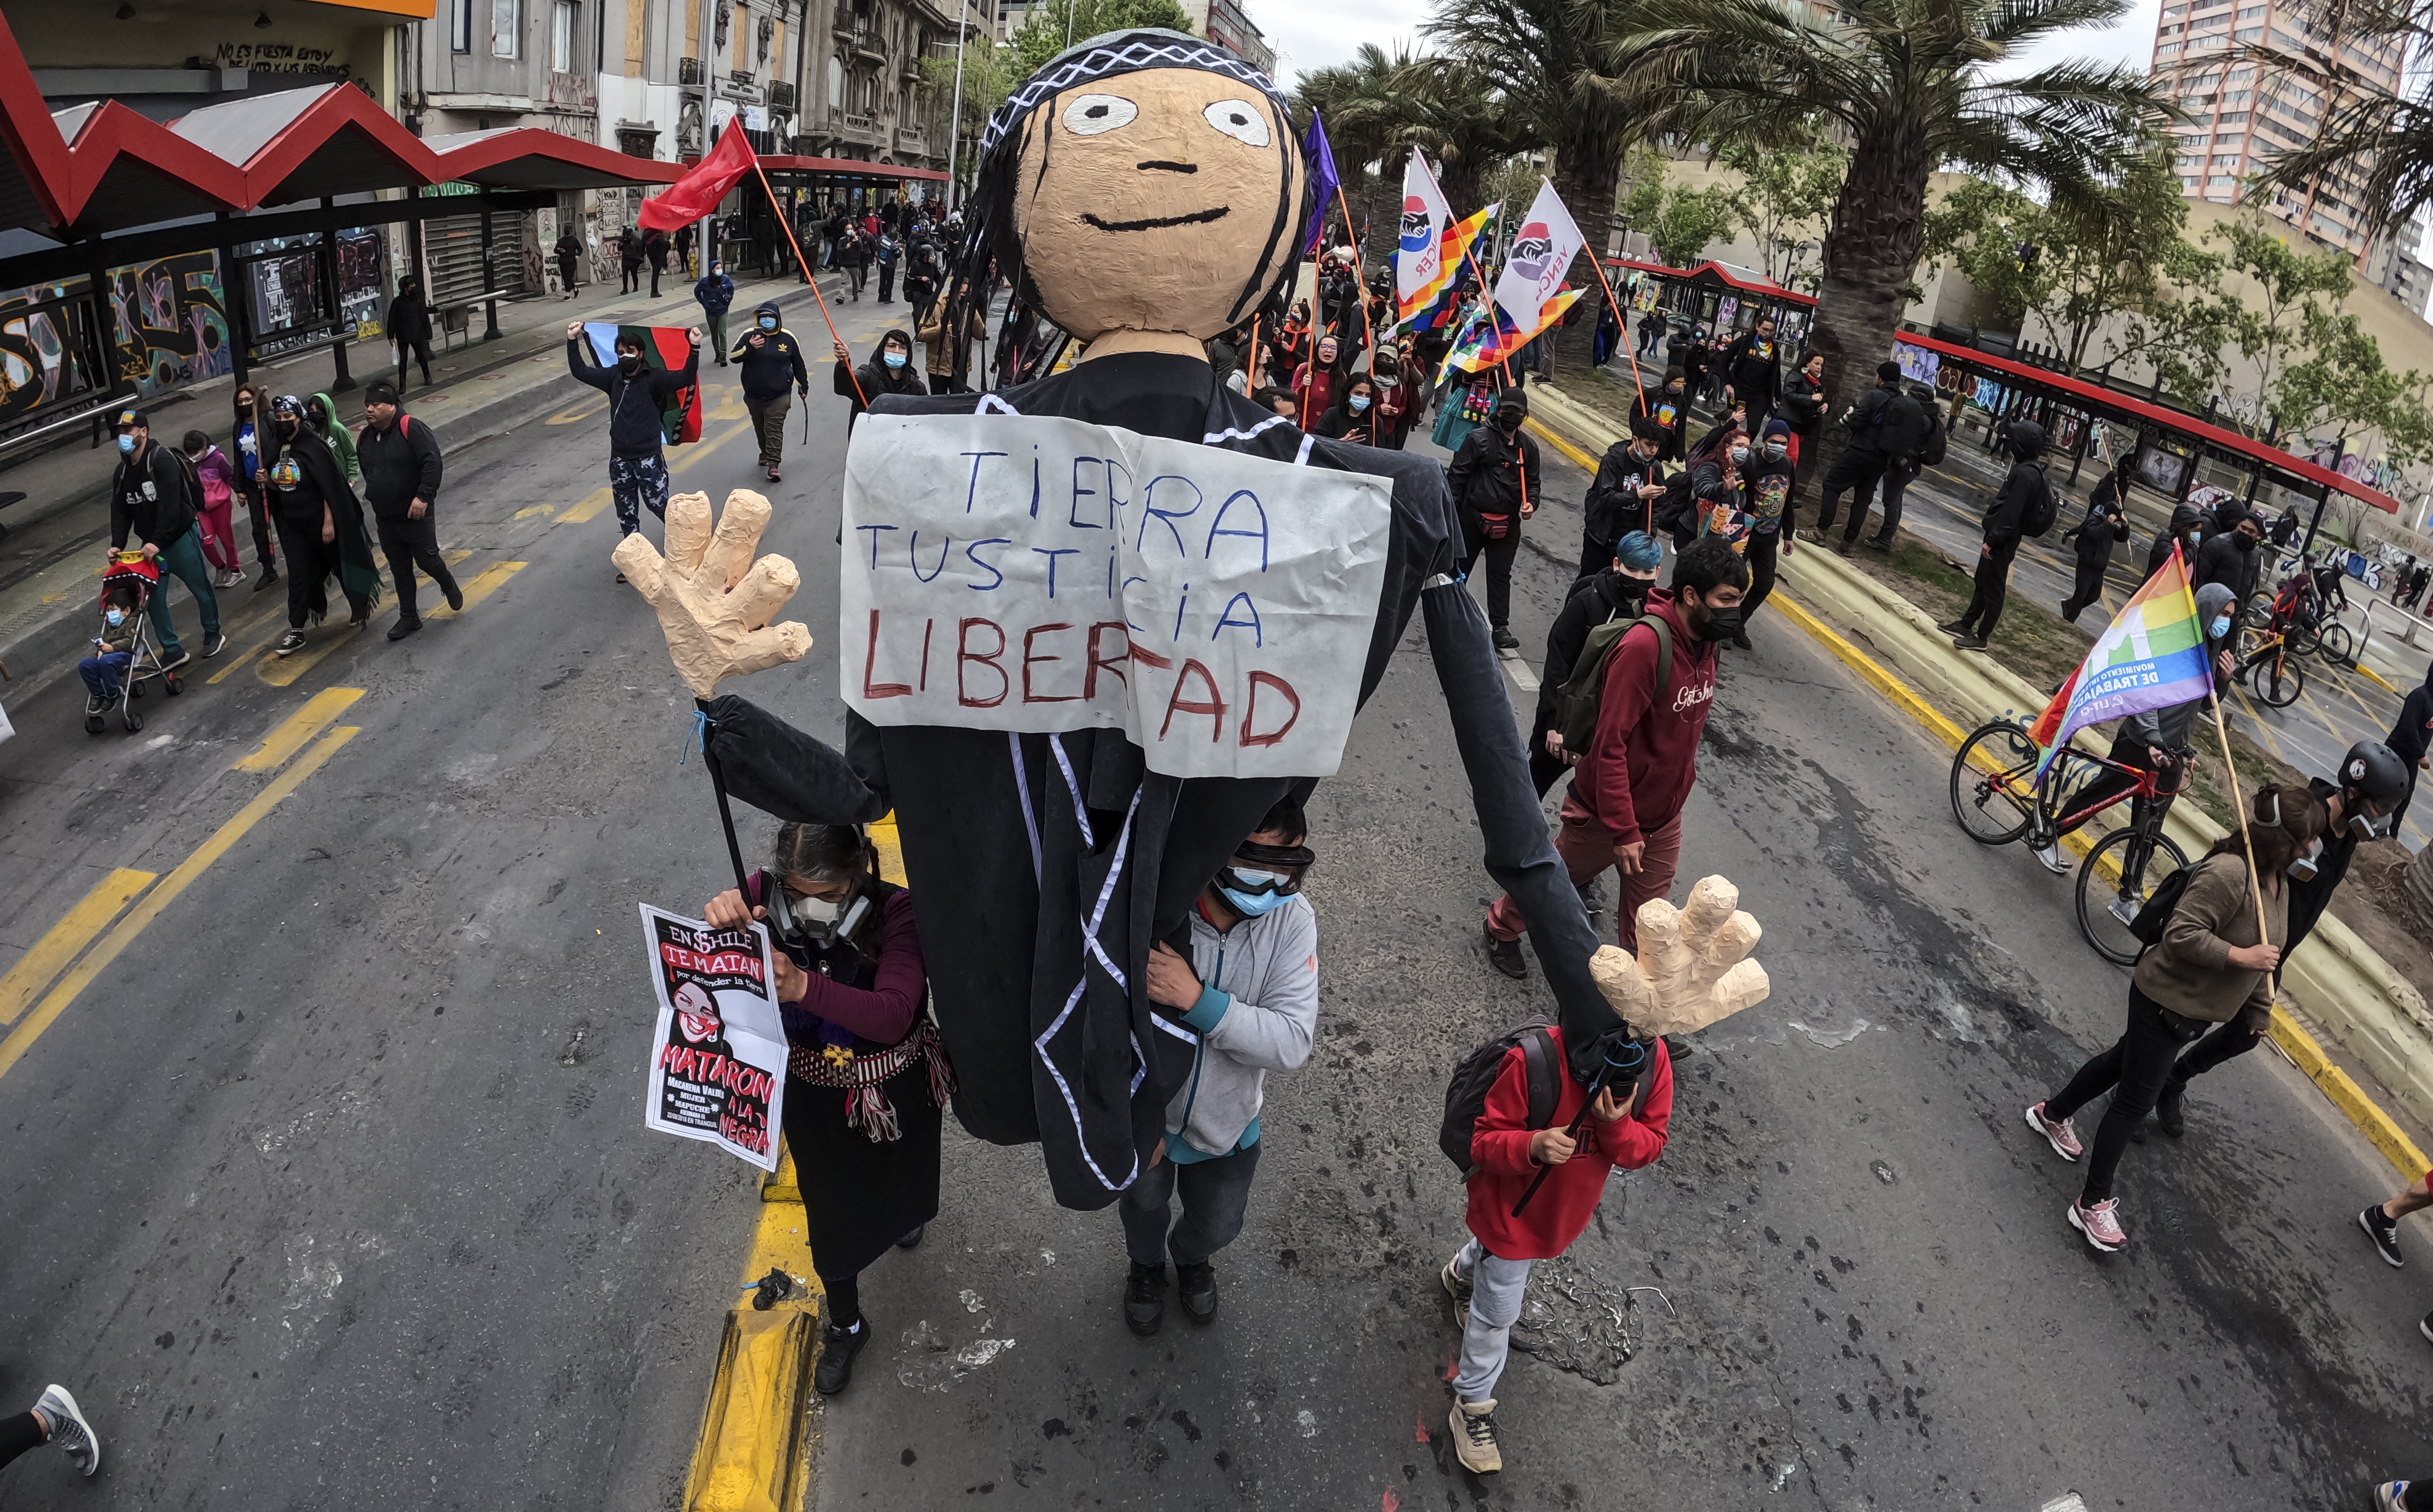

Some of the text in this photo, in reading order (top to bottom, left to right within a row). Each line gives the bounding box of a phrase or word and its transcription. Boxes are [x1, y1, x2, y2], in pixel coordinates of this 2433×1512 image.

[217, 43, 333, 64] NO ES FIESTA ESTOY
[863, 608, 1301, 749] LIBERTAD
[669, 926, 691, 946] EN
[665, 945, 759, 980] TE MATAN
[676, 970, 690, 979] por
[692, 974, 731, 987] defender
[734, 977, 744, 985] la
[659, 1043, 775, 1104] MATARON
[675, 1100, 710, 1114] MAPUCHE
[680, 1091, 706, 1104] MUJER
[728, 1096, 752, 1123] A LA
[719, 1113, 770, 1158] NEGRA
